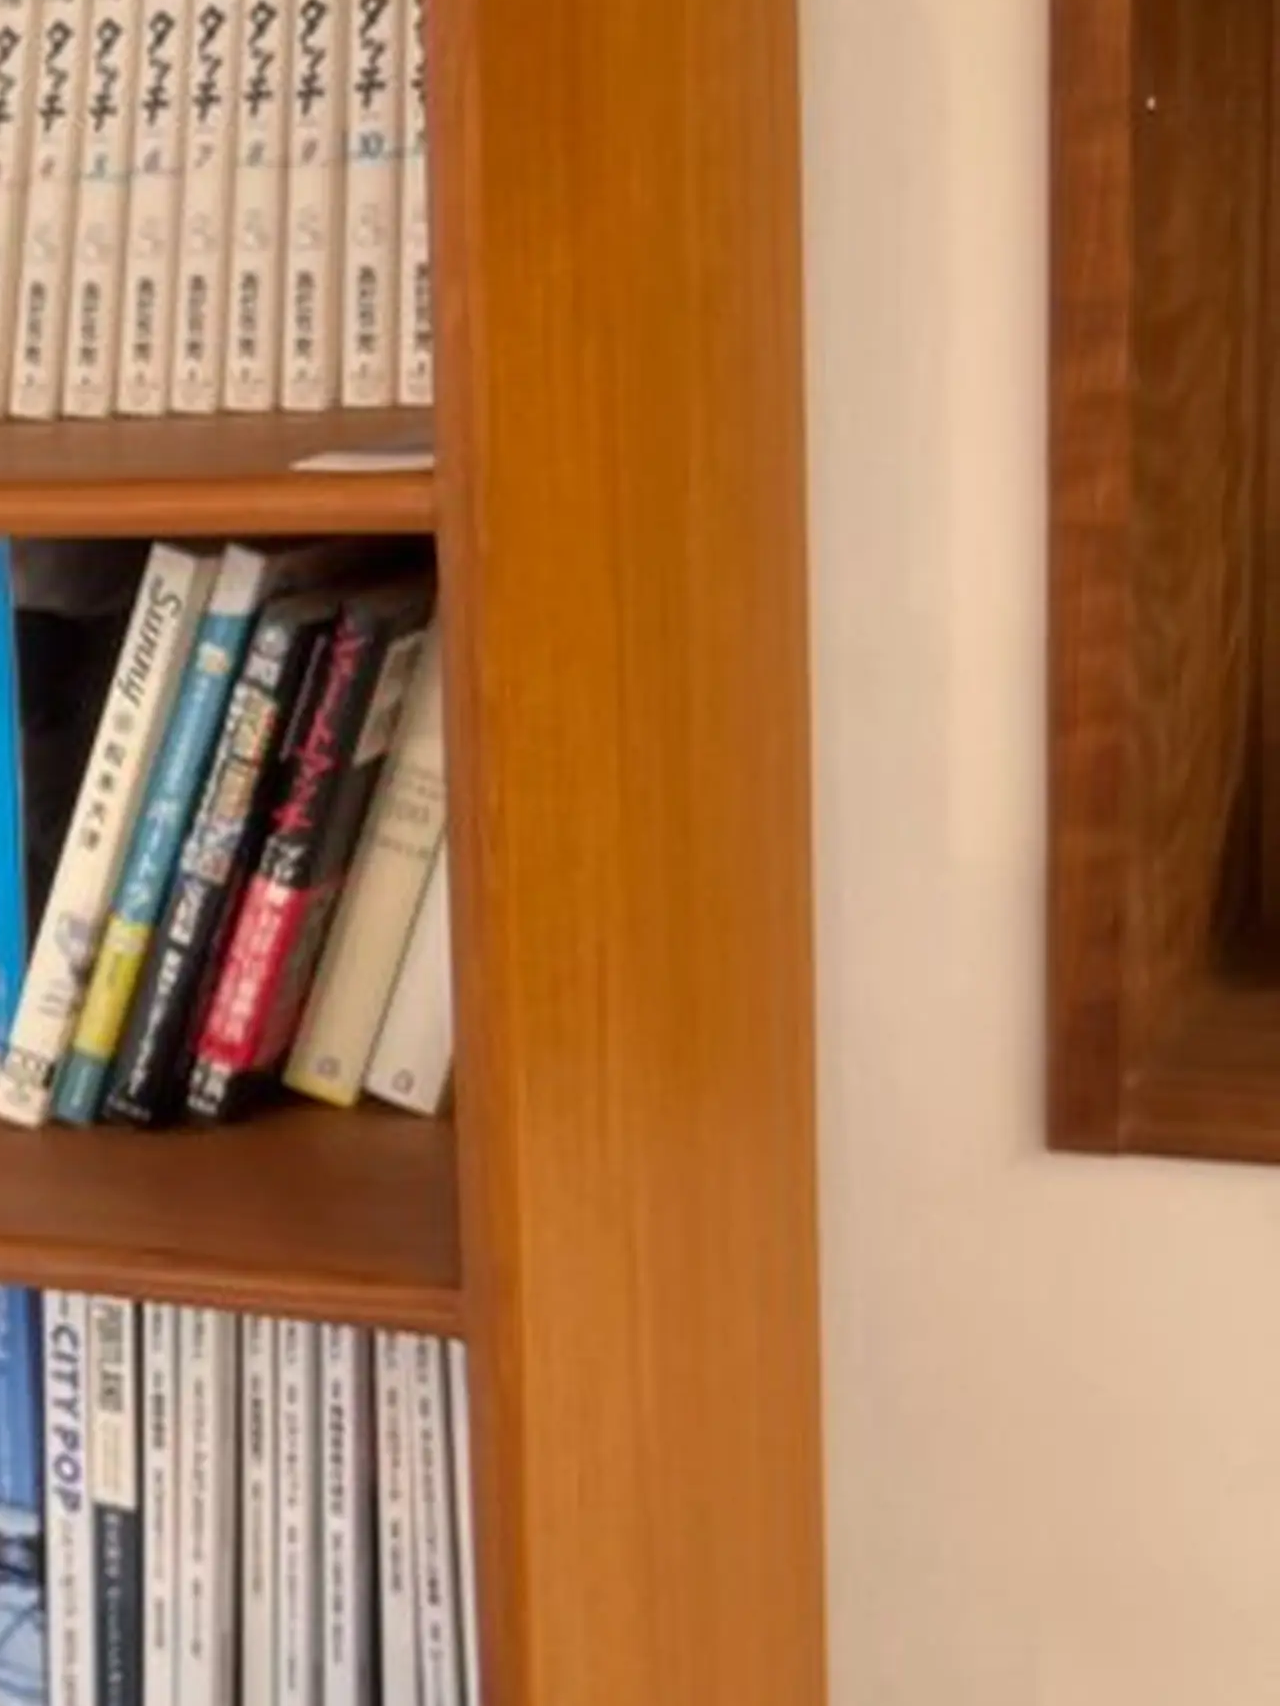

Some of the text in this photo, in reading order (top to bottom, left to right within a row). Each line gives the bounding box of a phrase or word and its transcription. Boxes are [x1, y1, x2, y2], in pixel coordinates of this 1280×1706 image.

[360, 130, 385, 159] 10
[119, 577, 183, 706] Sunny
[51, 1324, 80, 1420] CITY
[52, 1423, 82, 1514] POP
